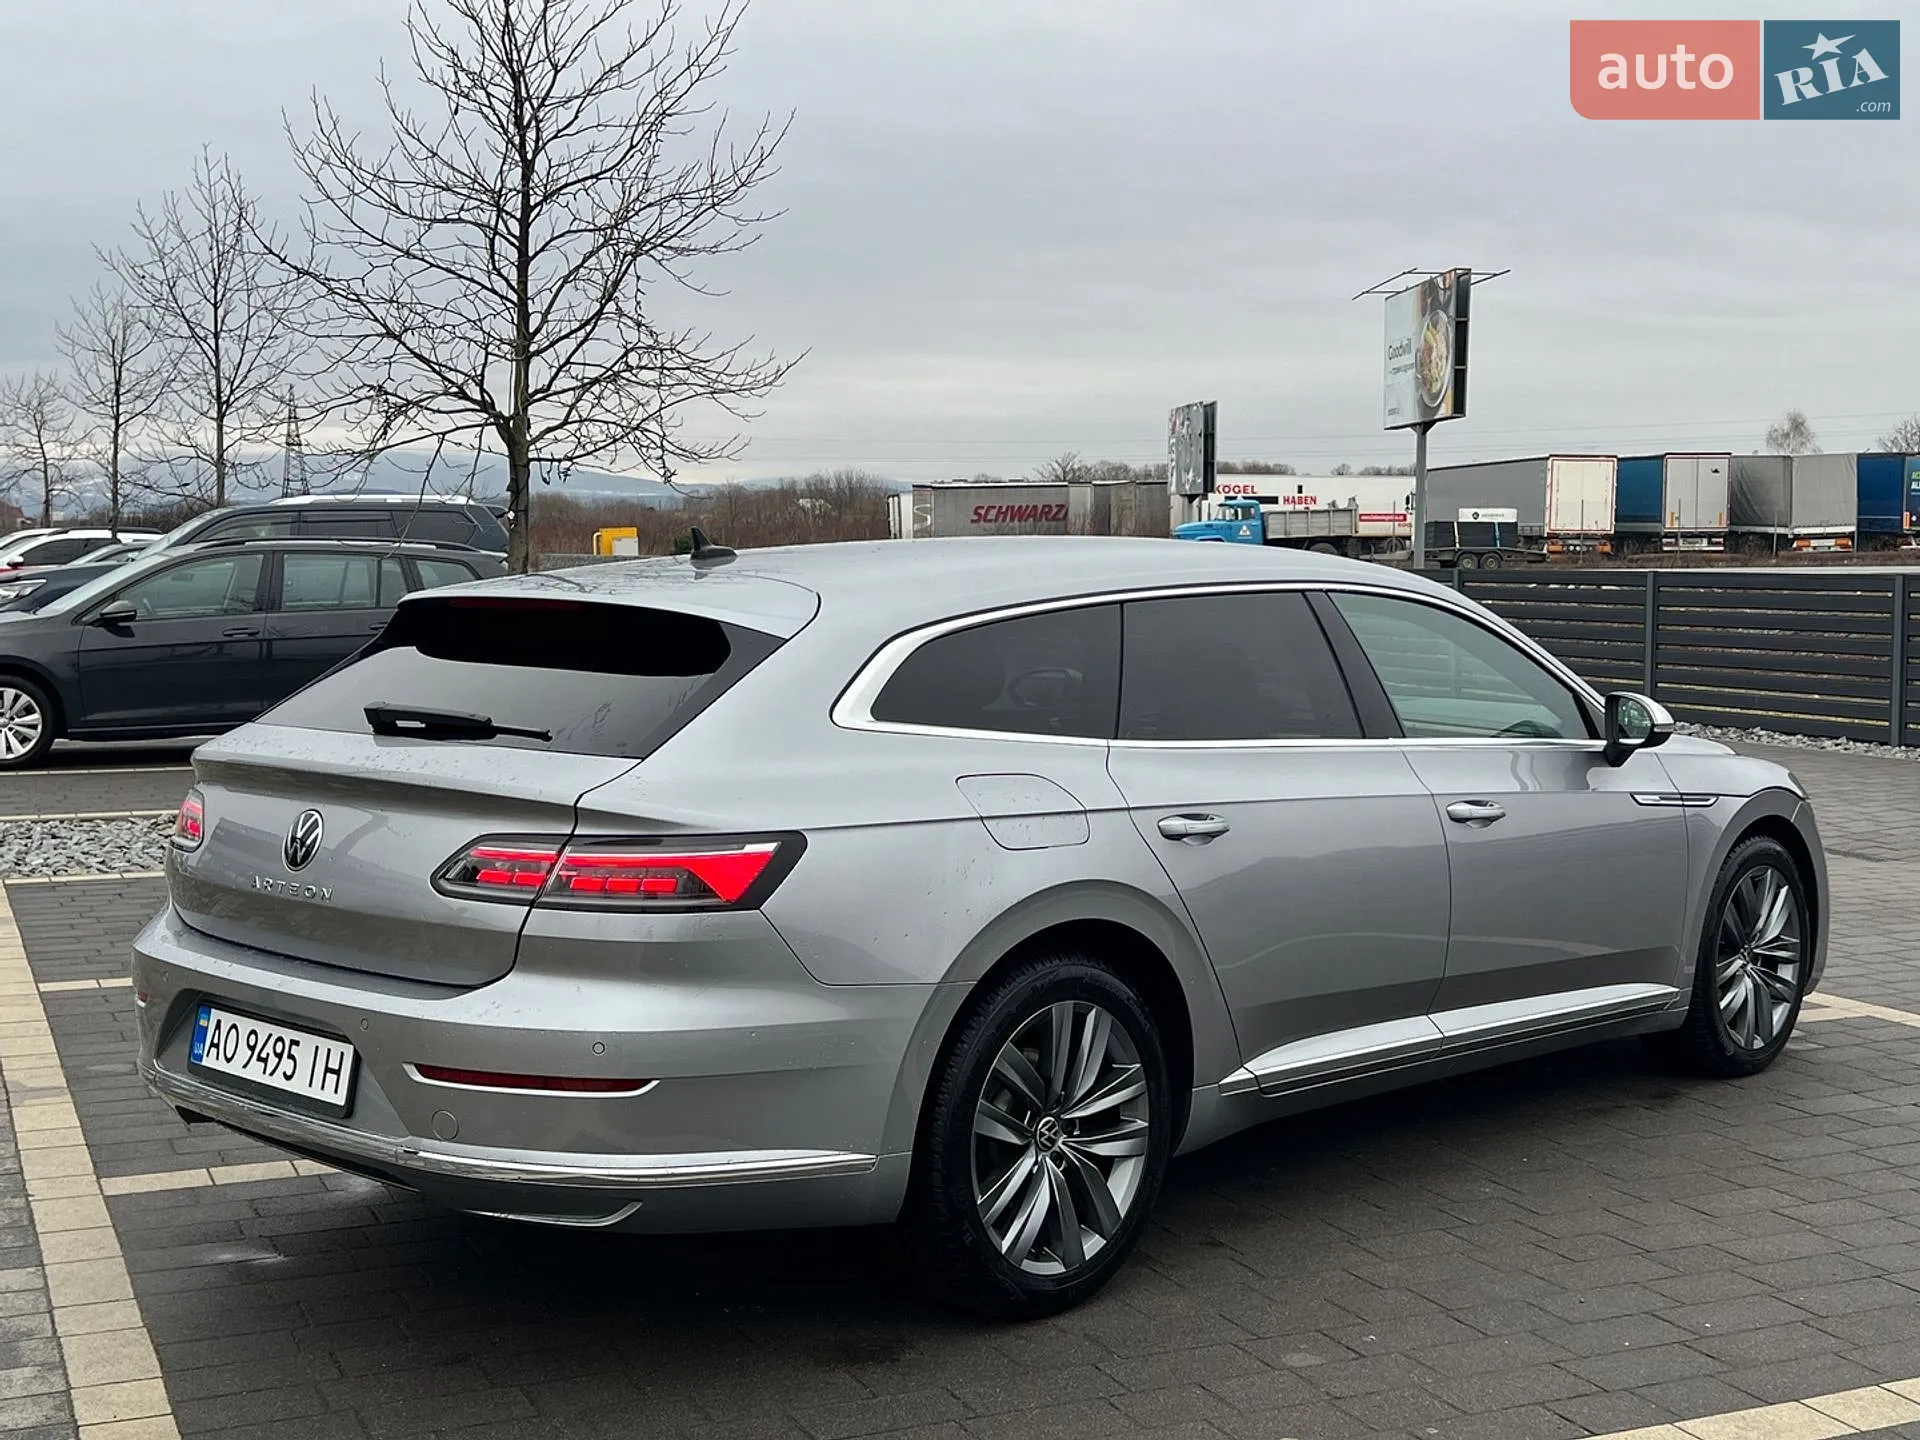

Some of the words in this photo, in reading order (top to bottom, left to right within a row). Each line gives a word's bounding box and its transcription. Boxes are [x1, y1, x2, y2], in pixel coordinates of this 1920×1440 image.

[1282, 495, 1317, 505] HABEN
[251, 874, 333, 902] ARTEON
[206, 1018, 240, 1064] AO
[242, 1028, 301, 1082] 9495
